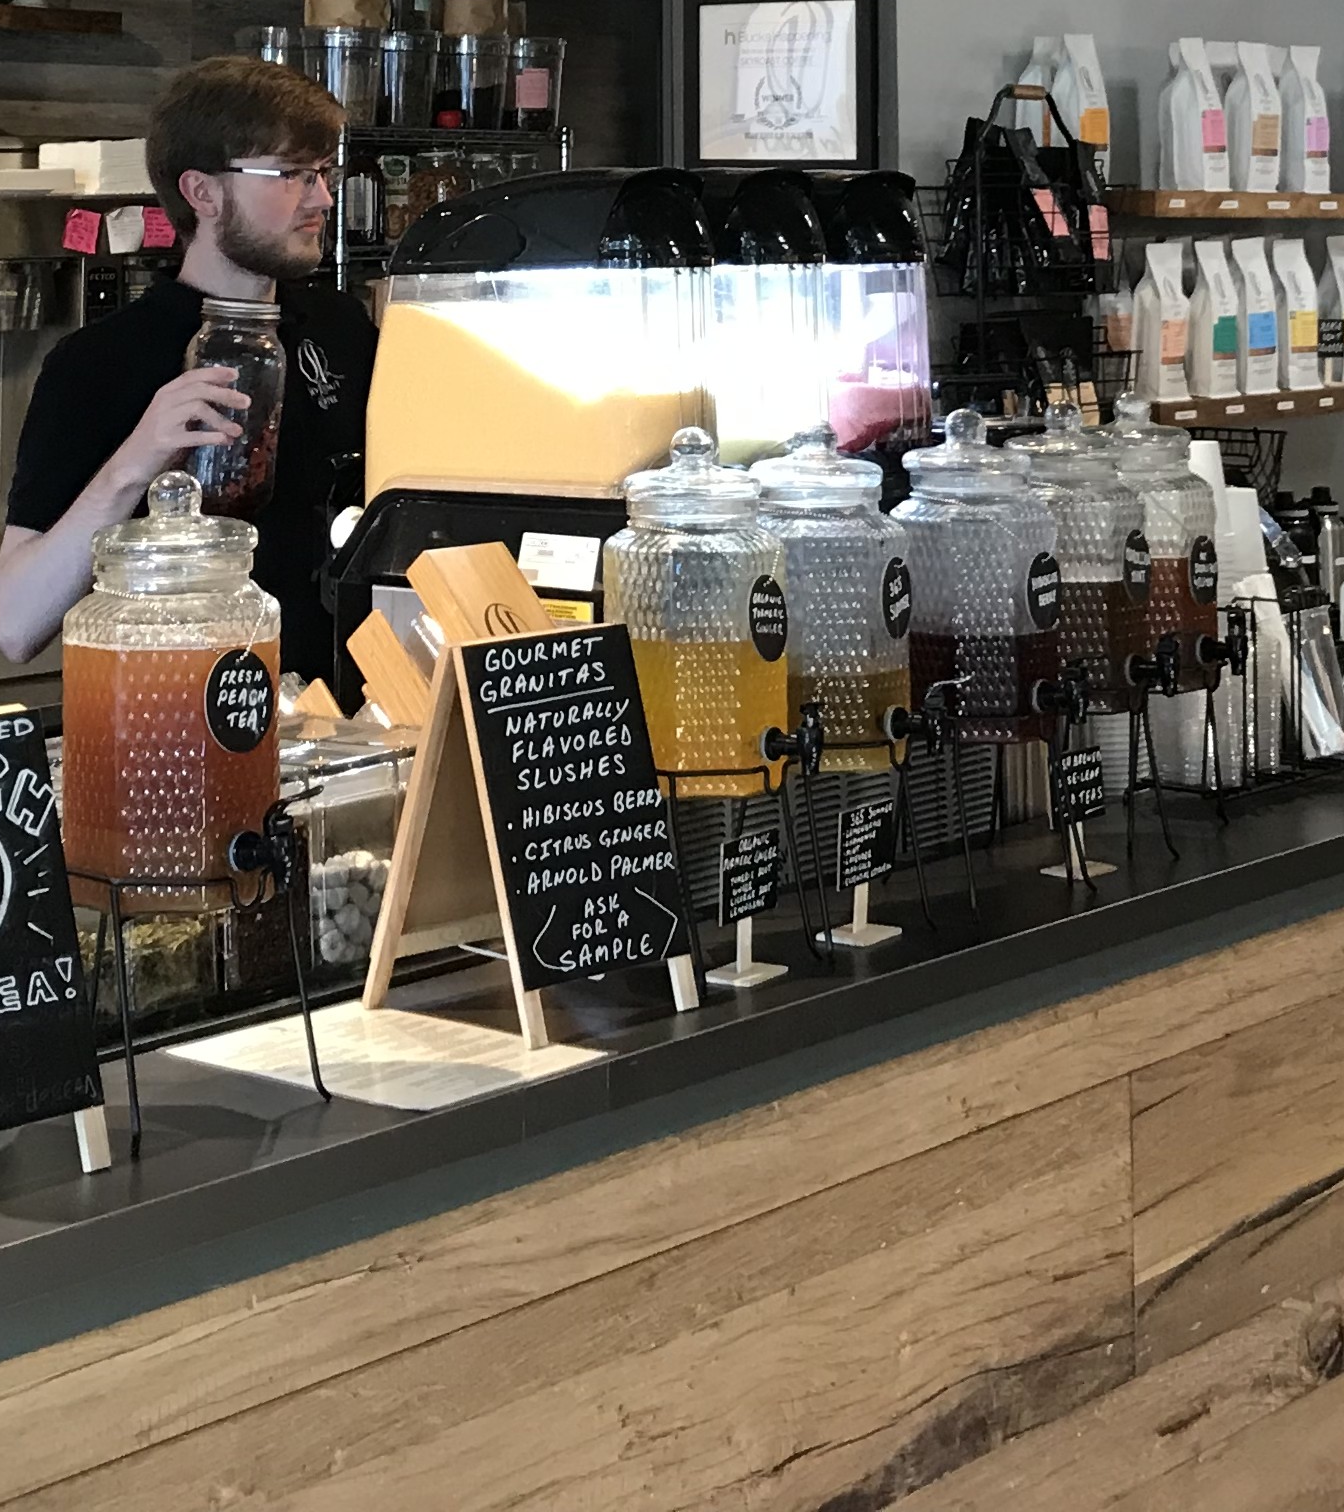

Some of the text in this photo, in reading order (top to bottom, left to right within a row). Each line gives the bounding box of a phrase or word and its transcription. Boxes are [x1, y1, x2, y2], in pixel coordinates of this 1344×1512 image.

[485, 637, 603, 672] GOURMET
[220, 669, 262, 688] FRESH
[480, 661, 606, 703] GRANITAS
[506, 698, 629, 737] NATURALLY
[512, 724, 632, 763] FLAVORED
[517, 755, 626, 791] SLUSHES
[523, 787, 662, 830] HIBISCUS BERRY
[525, 821, 667, 862] CITRUS GINGER
[527, 851, 675, 895] ARNOLD PALMER
[584, 893, 621, 916] ASK
[572, 910, 629, 940] FOR A
[560, 934, 653, 971] SAMPLE
